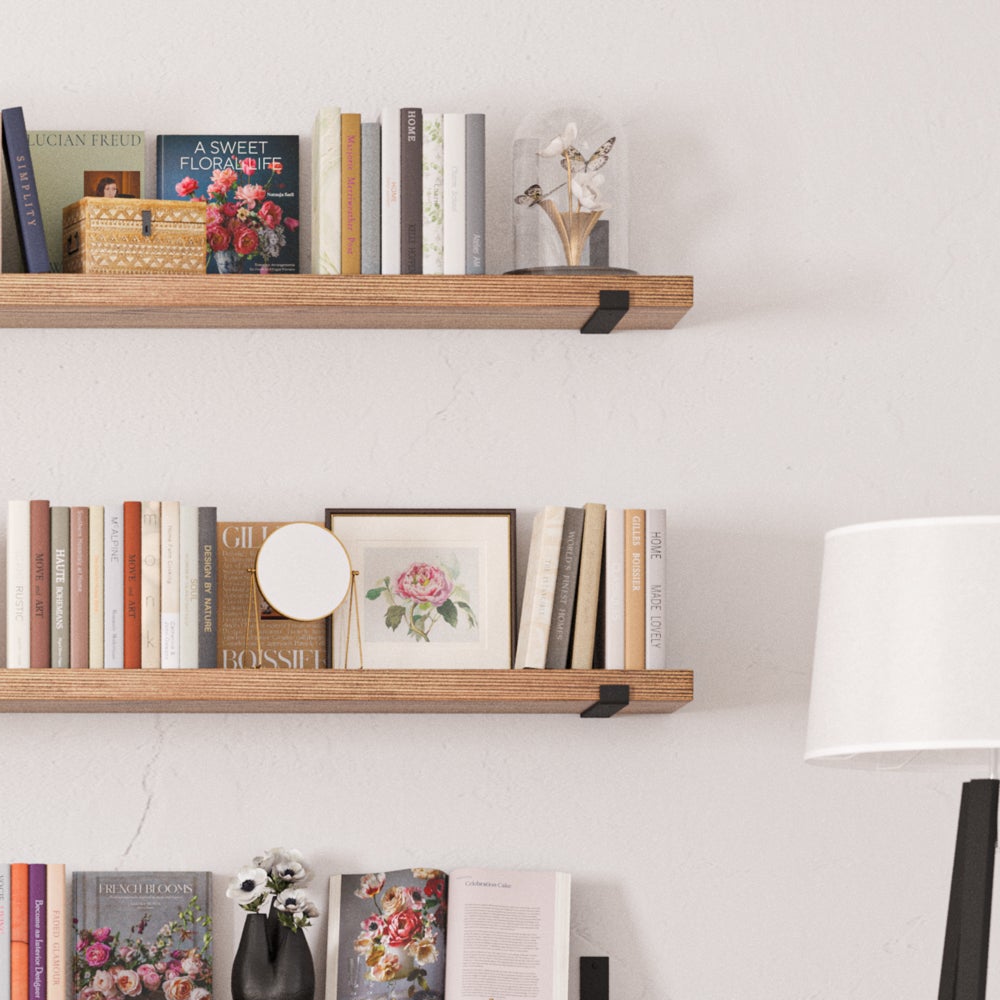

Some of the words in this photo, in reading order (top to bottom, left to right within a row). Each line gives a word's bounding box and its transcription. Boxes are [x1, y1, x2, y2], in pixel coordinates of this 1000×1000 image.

[28, 134, 86, 146] LUCIAN
[92, 134, 142, 146] FREUD
[408, 111, 416, 142] HOME
[194, 141, 206, 154] A
[211, 141, 268, 154] SWEET
[346, 135, 356, 170] Marjorie
[180, 156, 243, 170] FLORAL
[248, 156, 282, 170] LIFE
[16, 155, 36, 227] SIMPLITY
[346, 237, 356, 255] Post
[632, 515, 640, 546] GILLES
[650, 531, 662, 560] HOME
[35, 553, 43, 581] MOVE
[56, 549, 65, 583] HAUTE
[128, 554, 136, 581] MOVE
[203, 545, 212, 578] DESIGN
[632, 552, 640, 591] BOISSIER
[190, 578, 198, 602] SOUL
[203, 582, 212, 593] BY
[560, 574, 569, 605] FINEST
[650, 584, 662, 611] MADE
[15, 585, 24, 622] RUSTIC
[35, 599, 43, 619] ART
[55, 586, 63, 630] BOHEMIANS
[128, 600, 136, 619] ART
[203, 598, 212, 632] NATURE
[555, 608, 567, 641] HOMES
[650, 614, 662, 649] LOVELY
[99, 883, 142, 893] FRENCH
[145, 883, 193, 893] BLOOMS
[34, 899, 44, 928] Become
[34, 929, 40, 938] an
[34, 939, 44, 966] Interior
[33, 967, 44, 998] Designer
